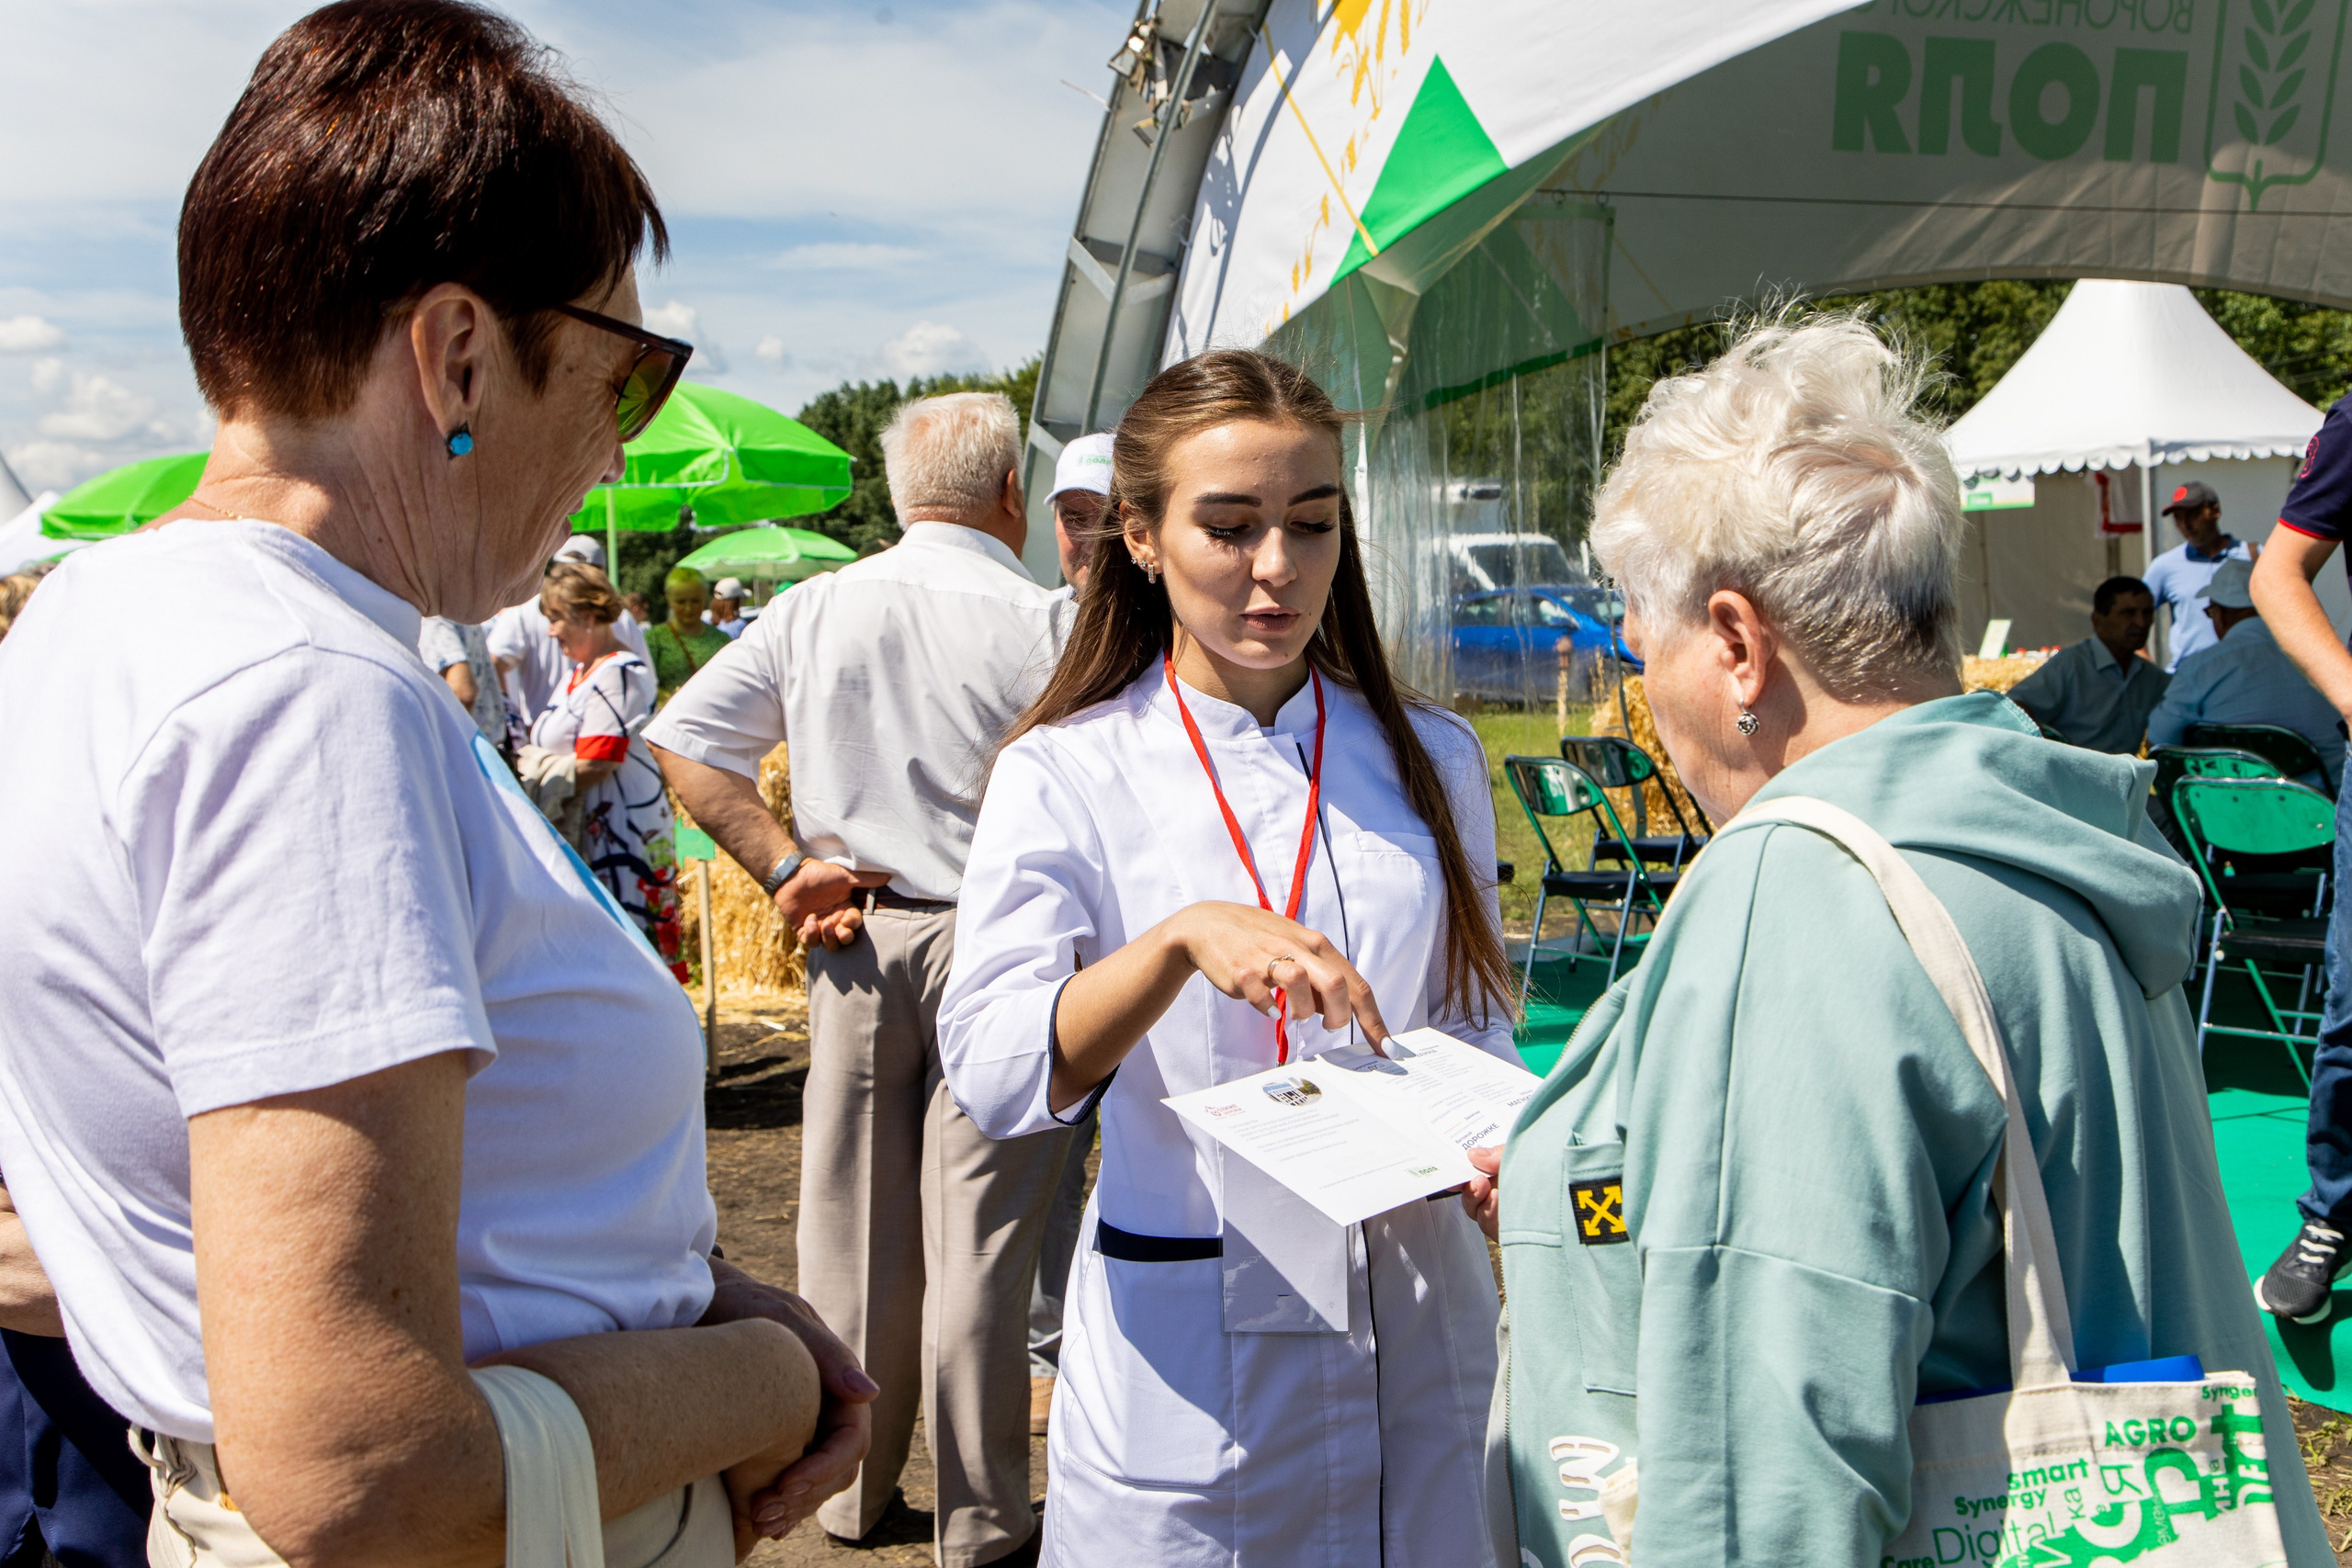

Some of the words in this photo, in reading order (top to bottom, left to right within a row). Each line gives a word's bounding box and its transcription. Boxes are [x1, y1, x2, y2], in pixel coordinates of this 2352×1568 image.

[1461, 1122, 1499, 1150] ДОРОЖКЕ
[2105, 1416, 2197, 1447] AGRO
[2007, 1458, 2089, 1491] smart
[1954, 1488, 2047, 1518] Synergy
[1932, 1511, 2055, 1565] Digital
